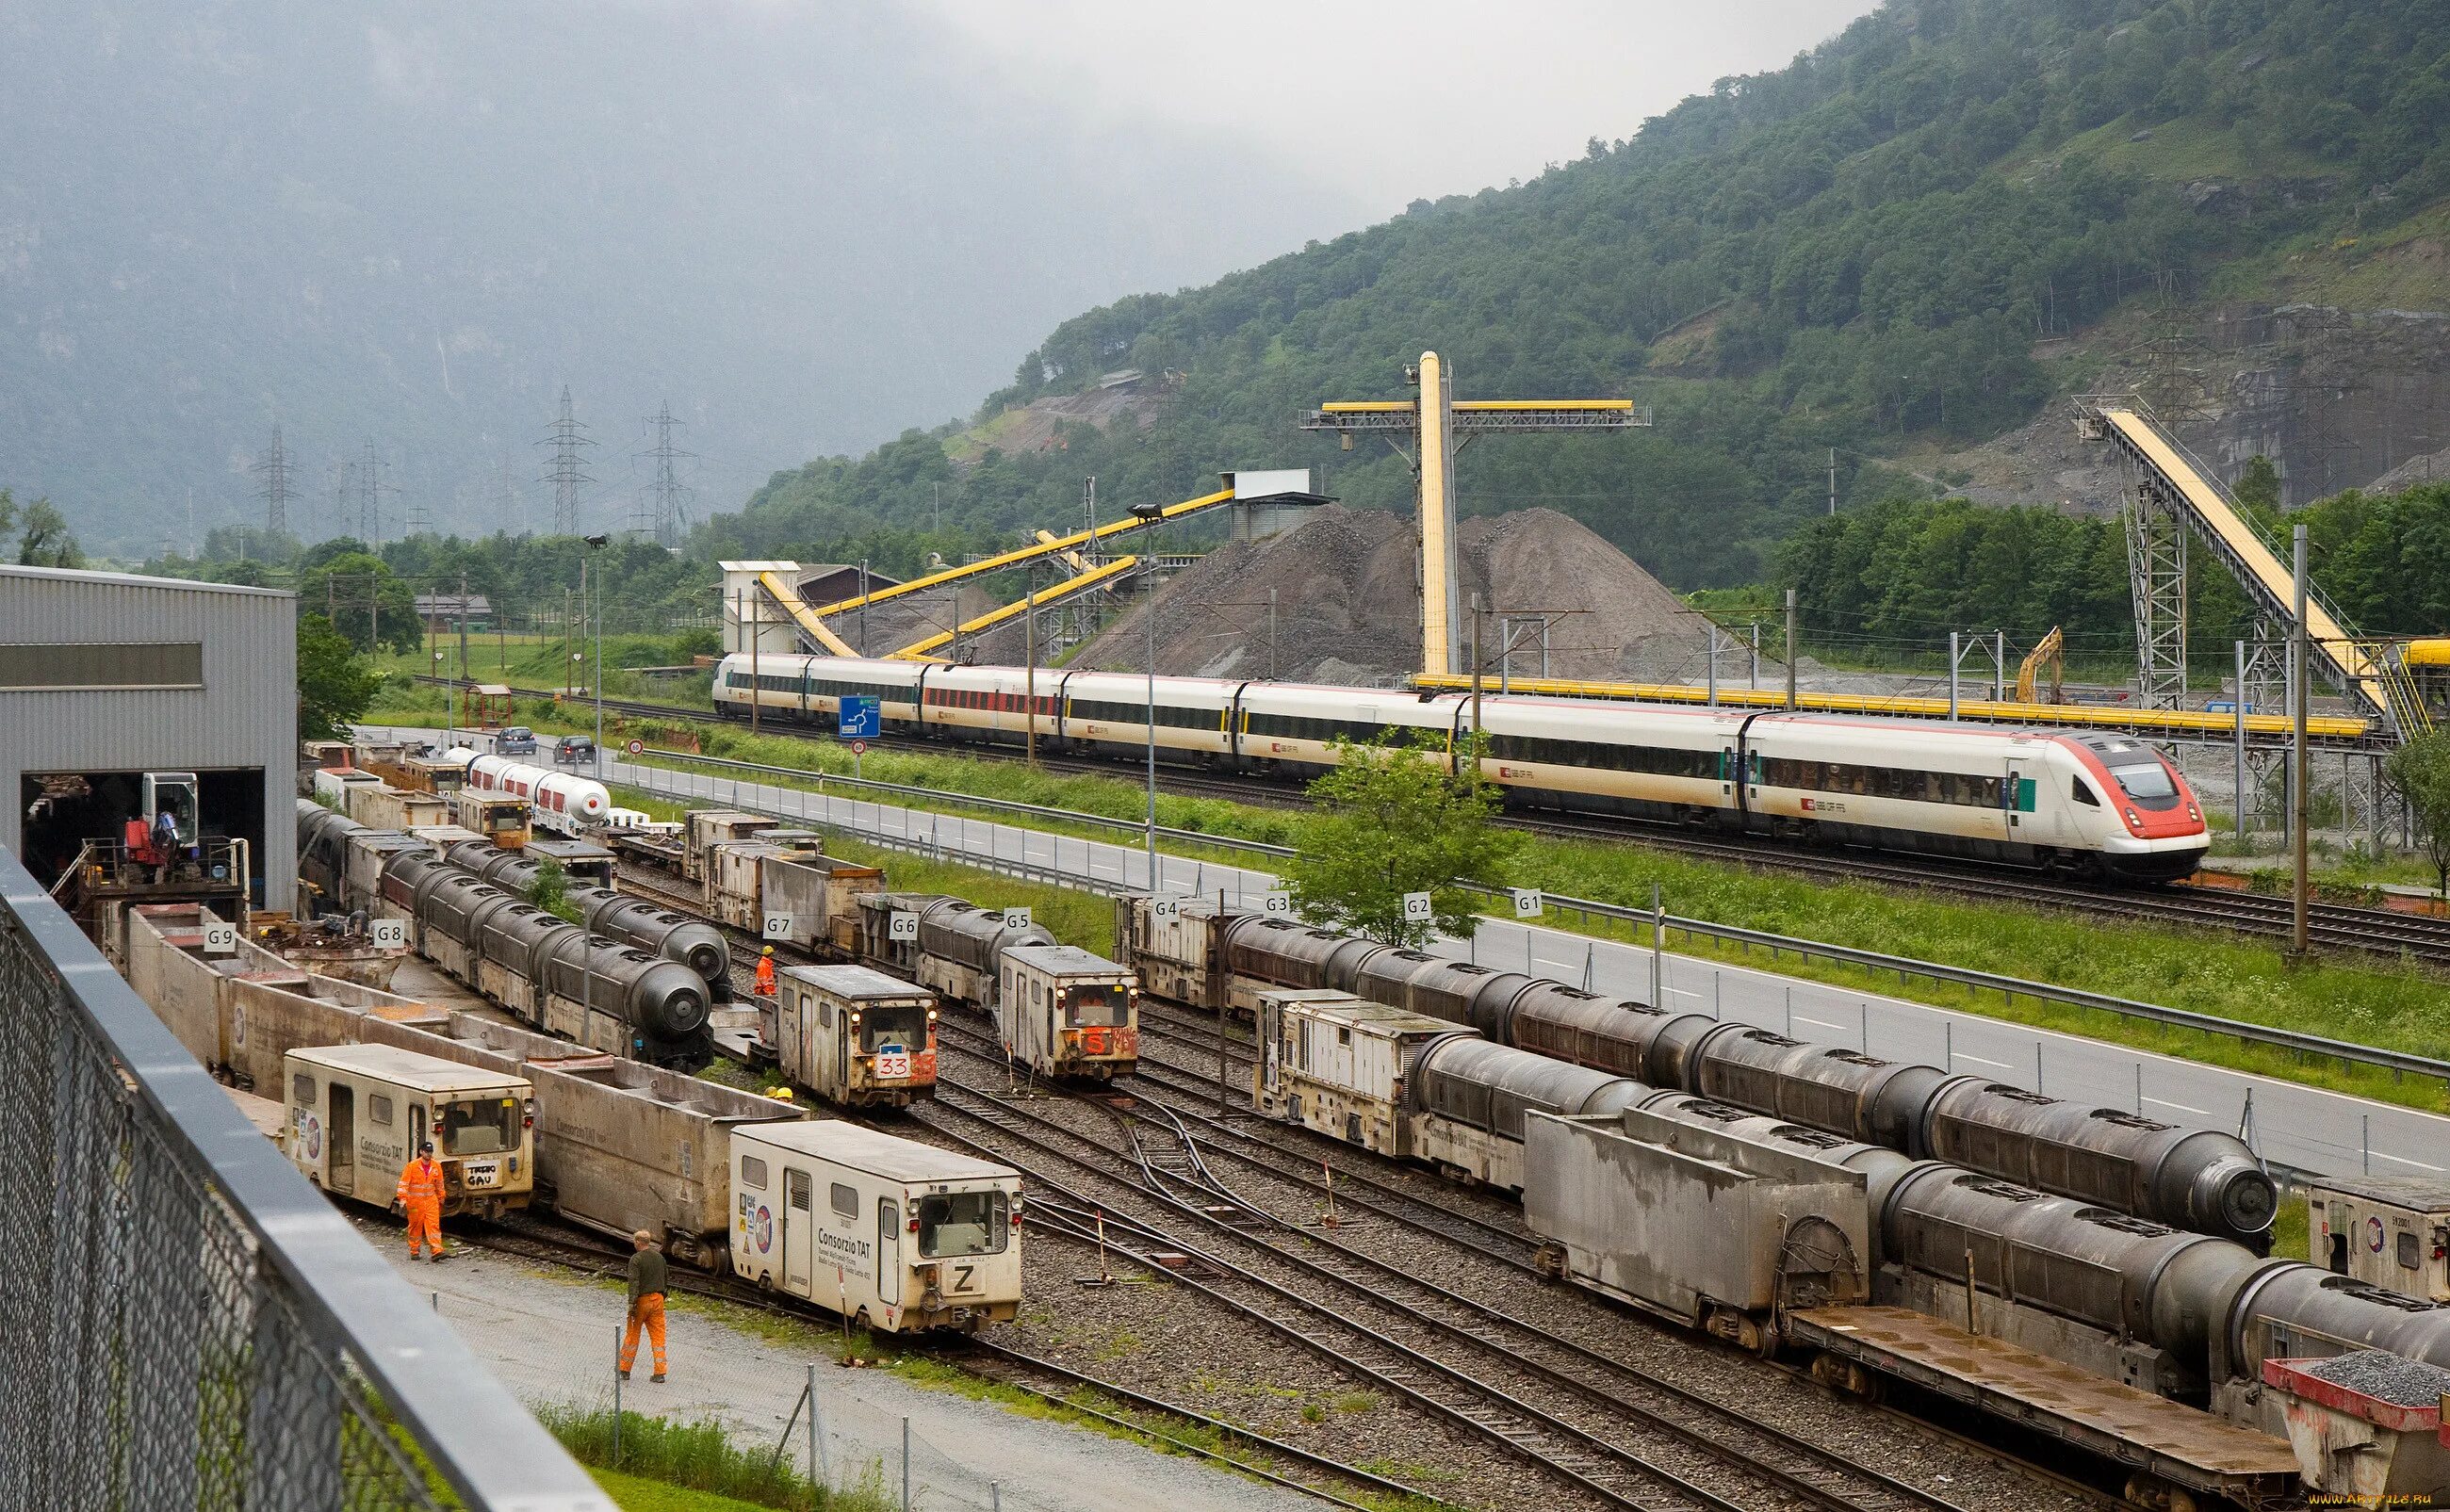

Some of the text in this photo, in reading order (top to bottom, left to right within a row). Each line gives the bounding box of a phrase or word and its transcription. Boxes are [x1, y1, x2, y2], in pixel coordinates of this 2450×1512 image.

[880, 1058, 907, 1075] 33
[361, 1135, 392, 1158] Consorzio
[391, 1145, 403, 1162] TAT
[467, 1175, 492, 1186] GAU
[818, 1227, 871, 1260] Consorzio TAT
[954, 1265, 974, 1293] Z
